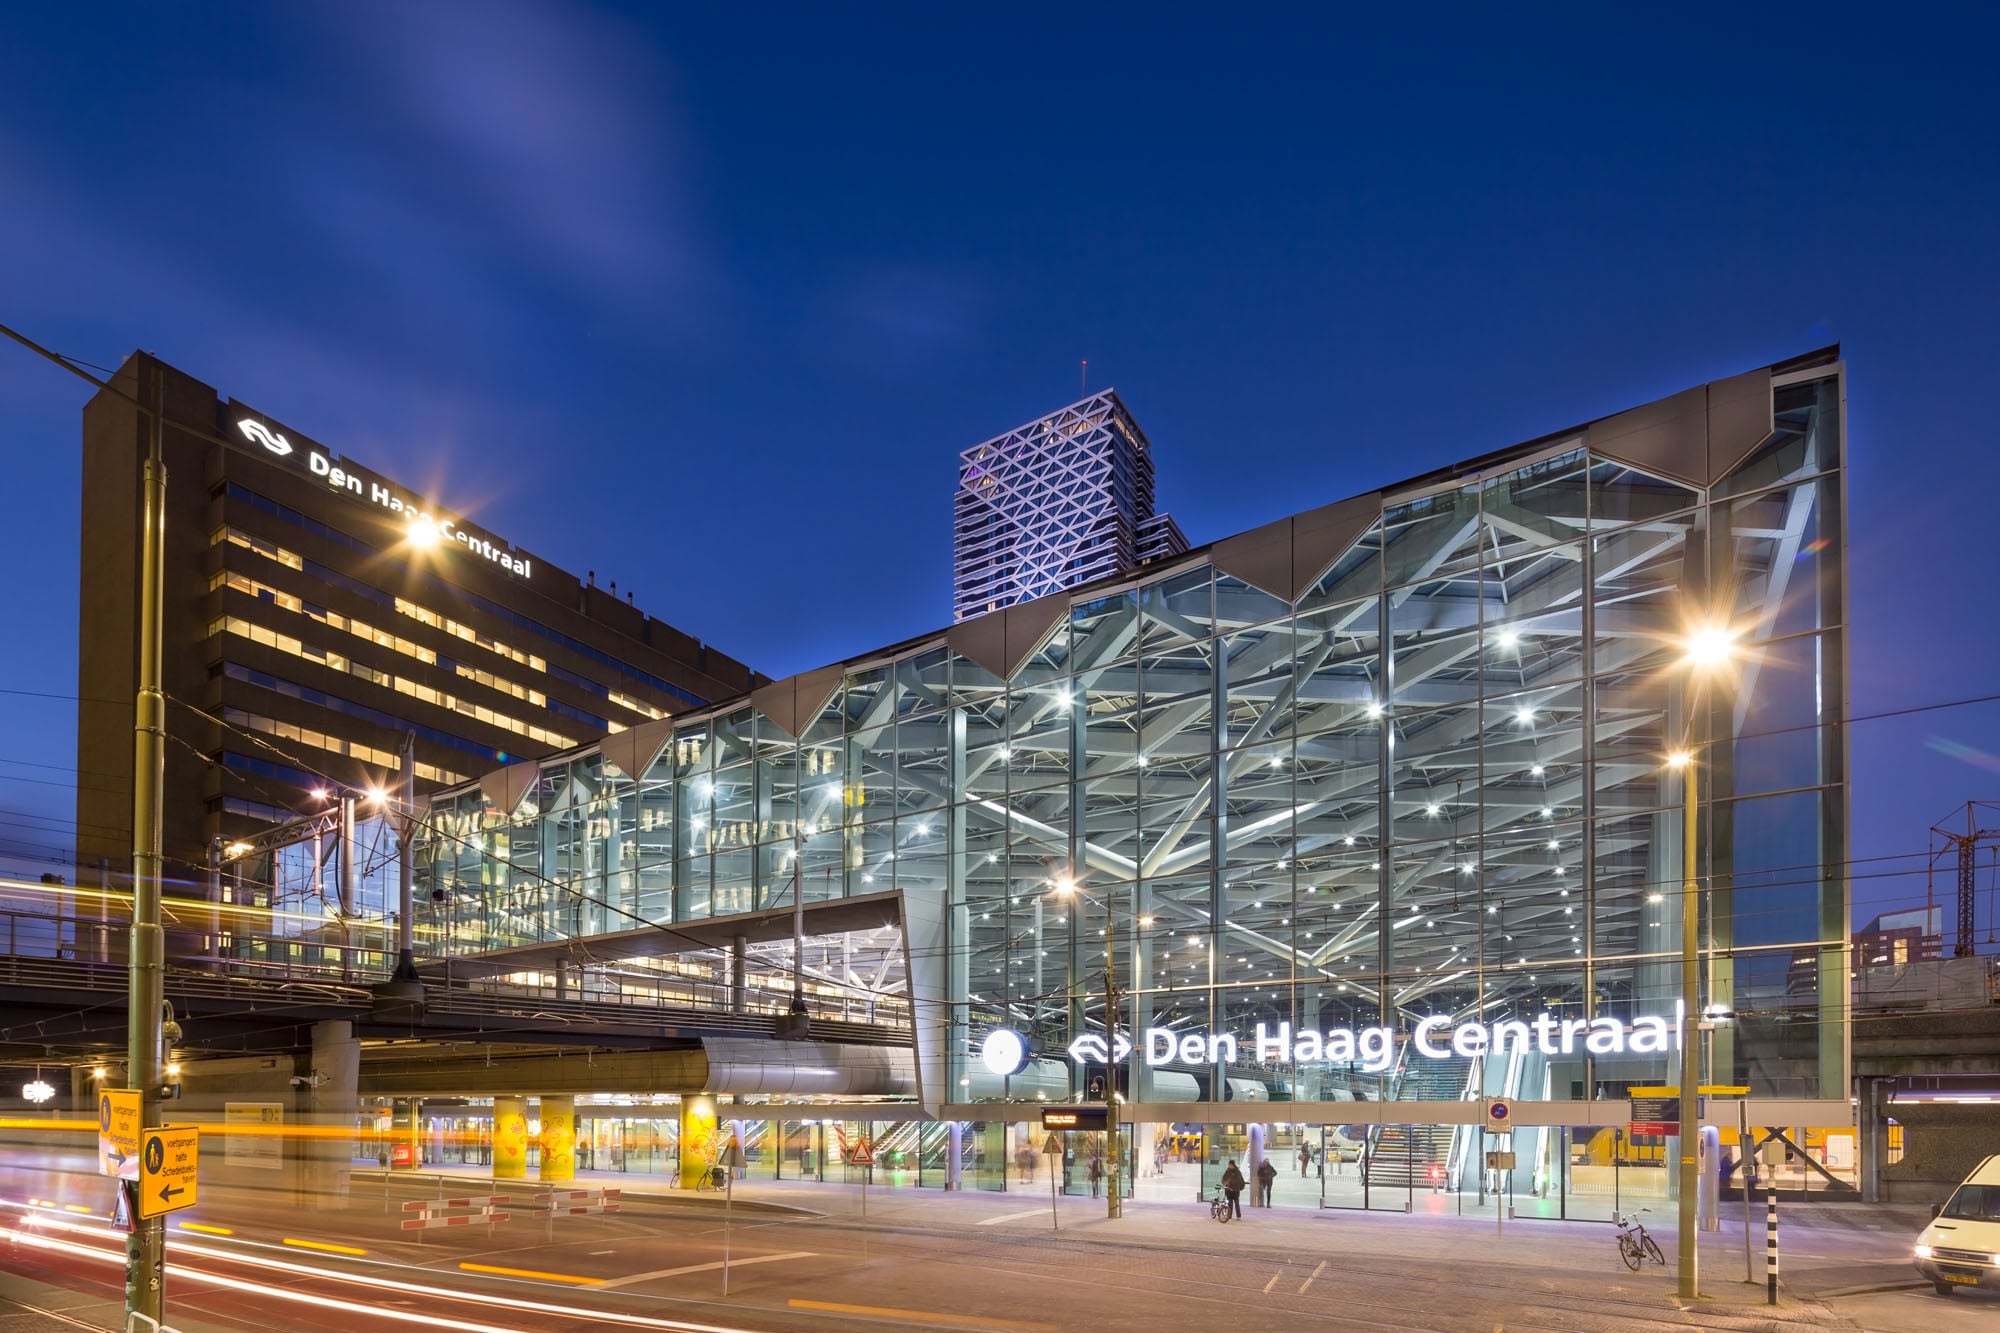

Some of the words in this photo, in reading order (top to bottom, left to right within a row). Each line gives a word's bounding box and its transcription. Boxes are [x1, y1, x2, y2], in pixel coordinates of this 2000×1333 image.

[310, 451, 363, 495] Den
[371, 482, 433, 522] Haa
[440, 519, 531, 579] Centraal
[1146, 1028, 1237, 1066] Den
[1256, 1021, 1393, 1071] Haag
[1414, 999, 1684, 1058] Centraal
